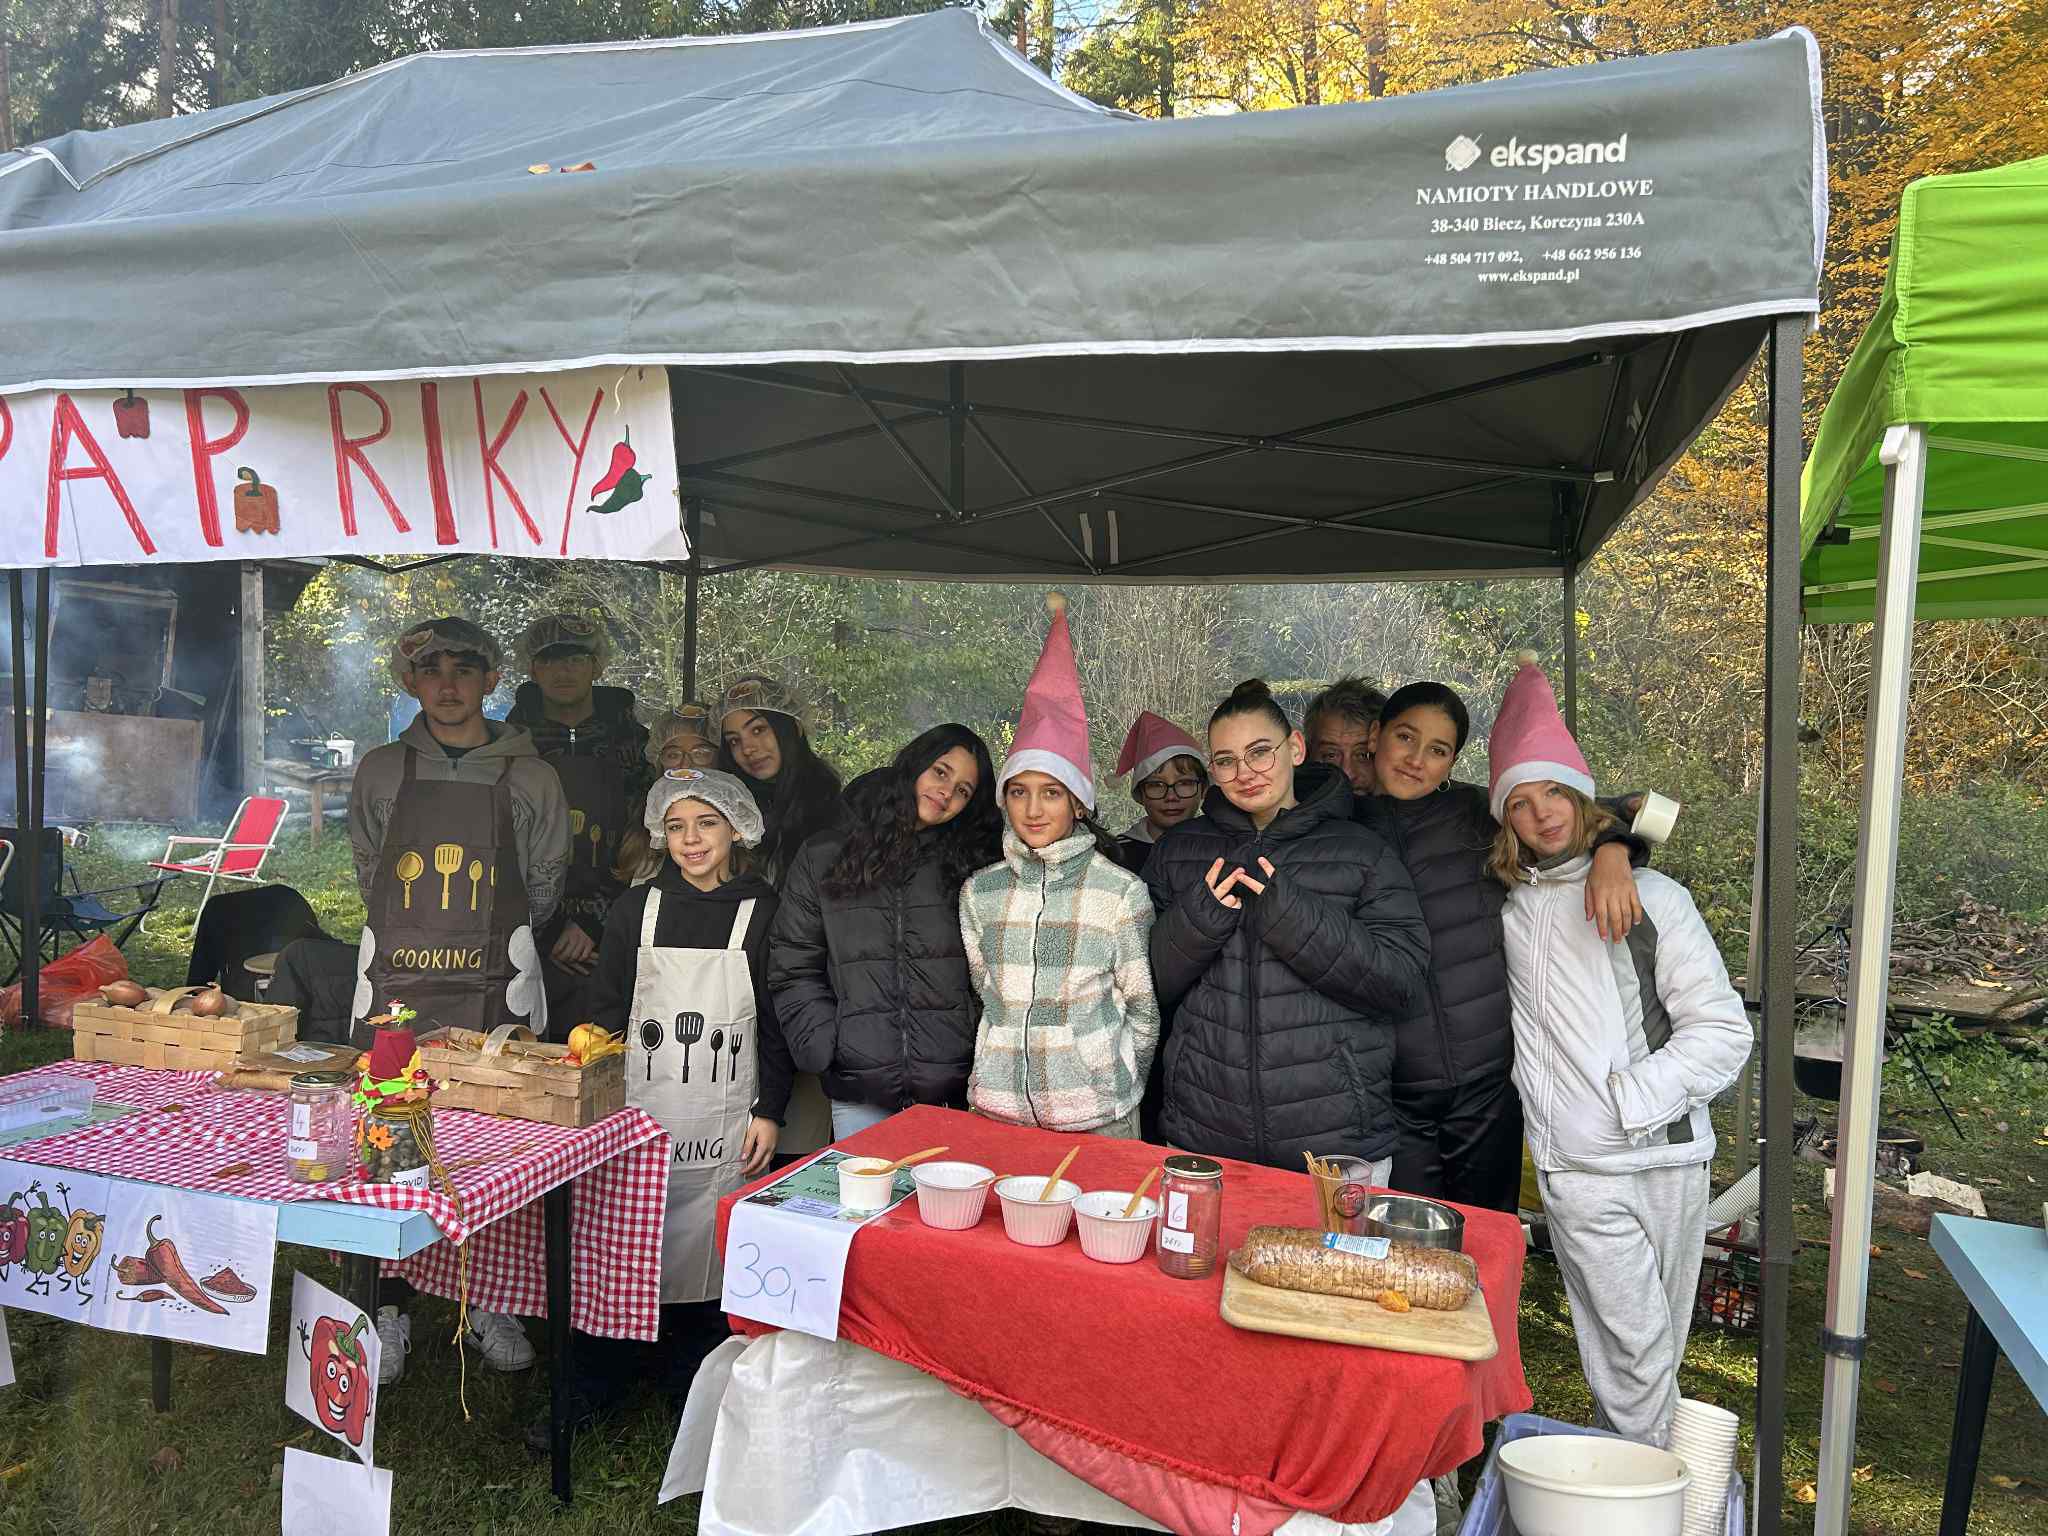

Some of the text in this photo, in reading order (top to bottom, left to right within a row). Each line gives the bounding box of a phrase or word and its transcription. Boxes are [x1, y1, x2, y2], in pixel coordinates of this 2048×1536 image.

[1490, 133, 1628, 174] ekspand
[1416, 180, 1654, 205] NAMIOTY HANDLOWE
[1430, 212, 1645, 233] 38-340 Biecz, Korczyna 230A
[1424, 246, 1642, 266] +48 504 717 092, +48 662 956 136
[1478, 268, 1580, 284] www.ekspand.pl
[392, 948, 483, 969] COOKING
[673, 1137, 724, 1163] KING
